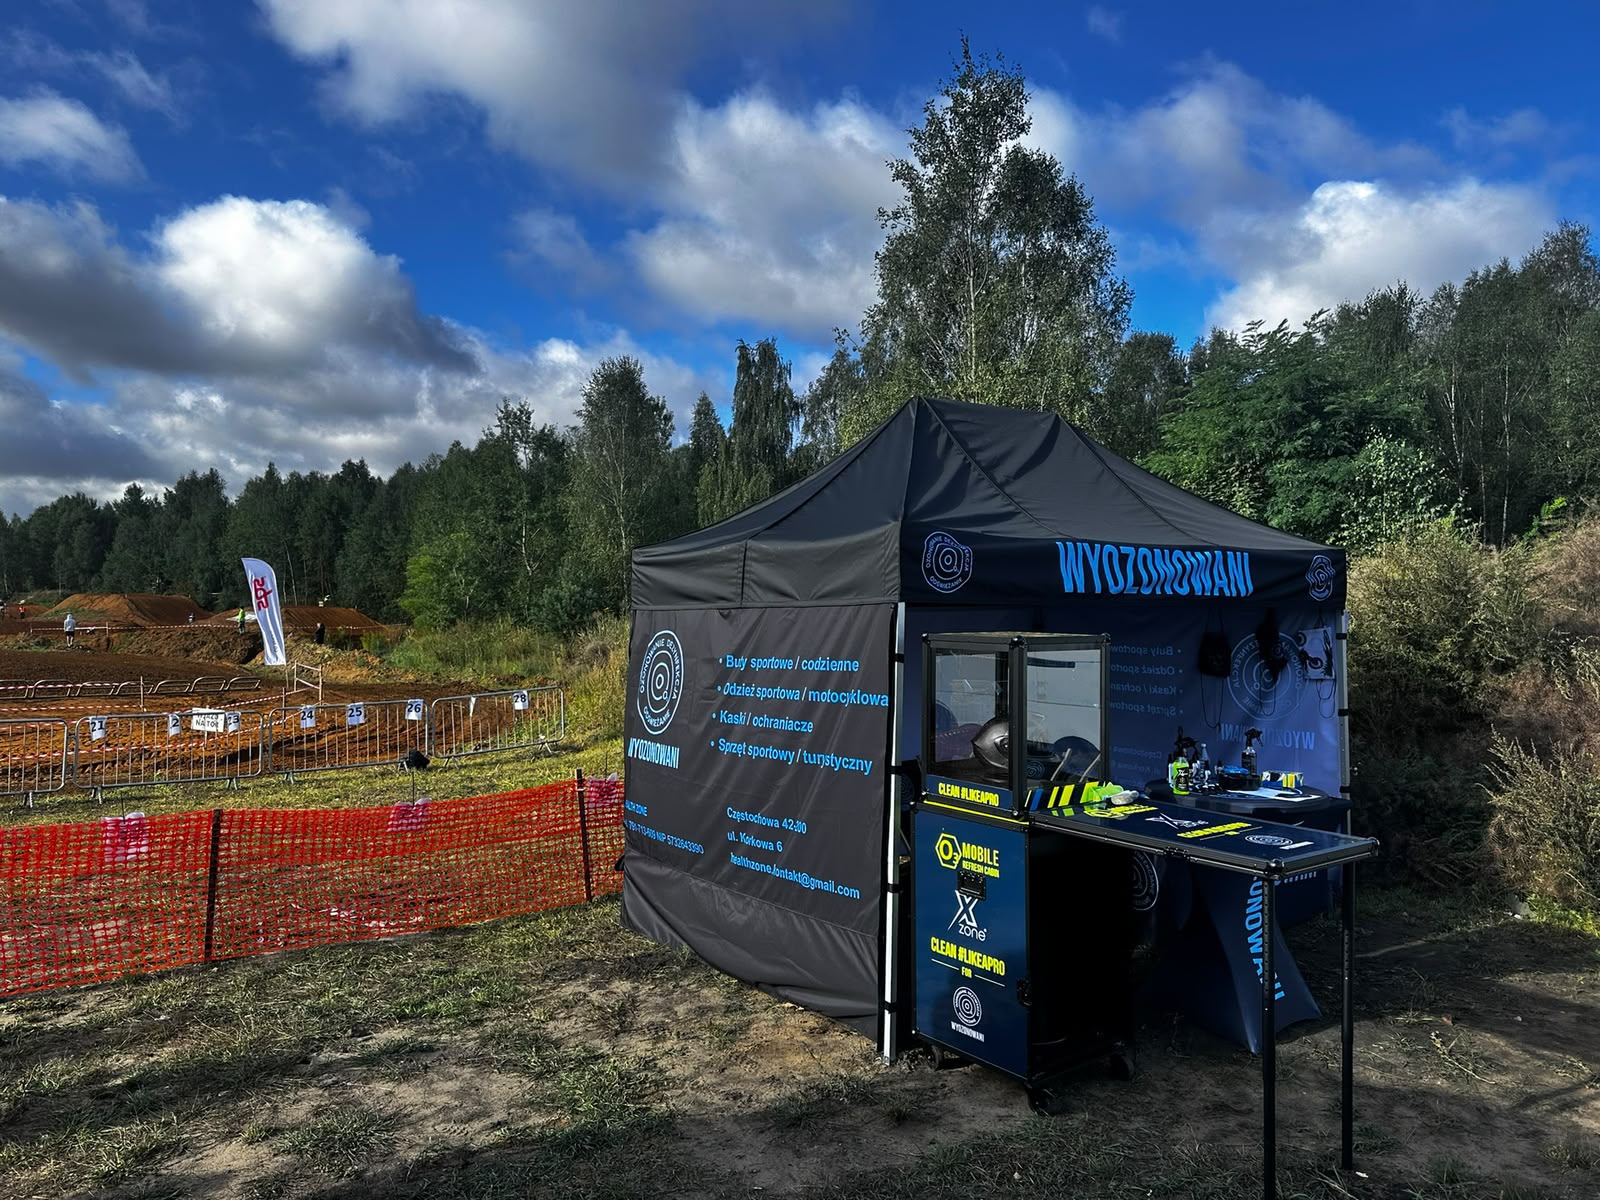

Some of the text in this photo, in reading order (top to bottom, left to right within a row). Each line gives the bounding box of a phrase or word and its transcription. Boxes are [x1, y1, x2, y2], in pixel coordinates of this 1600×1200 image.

[1055, 541, 1254, 597] WYOZONOWANI
[726, 654, 860, 673] Buty sportowe / codzienne
[514, 694, 526, 702] 28
[723, 682, 889, 707] Odzież sportowa / motocyklowa
[301, 709, 313, 720] 24
[348, 707, 362, 718] 25
[407, 703, 421, 713] 26
[91, 721, 105, 733] 21
[719, 710, 747, 726] Kaski
[752, 714, 814, 733] ochraniacze
[718, 738, 747, 758] Sprzęt
[747, 743, 796, 766] sportowy
[796, 748, 802, 763] /
[938, 782, 999, 807] CLEAN #LIKEAPRO
[726, 806, 780, 829] Częstochowa
[776, 841, 784, 852] 6
[962, 842, 999, 867] MOBILE
[958, 923, 987, 942] zone
[931, 936, 1005, 976] CLEAN #LIKEAPRO
[961, 966, 973, 978] FOR
